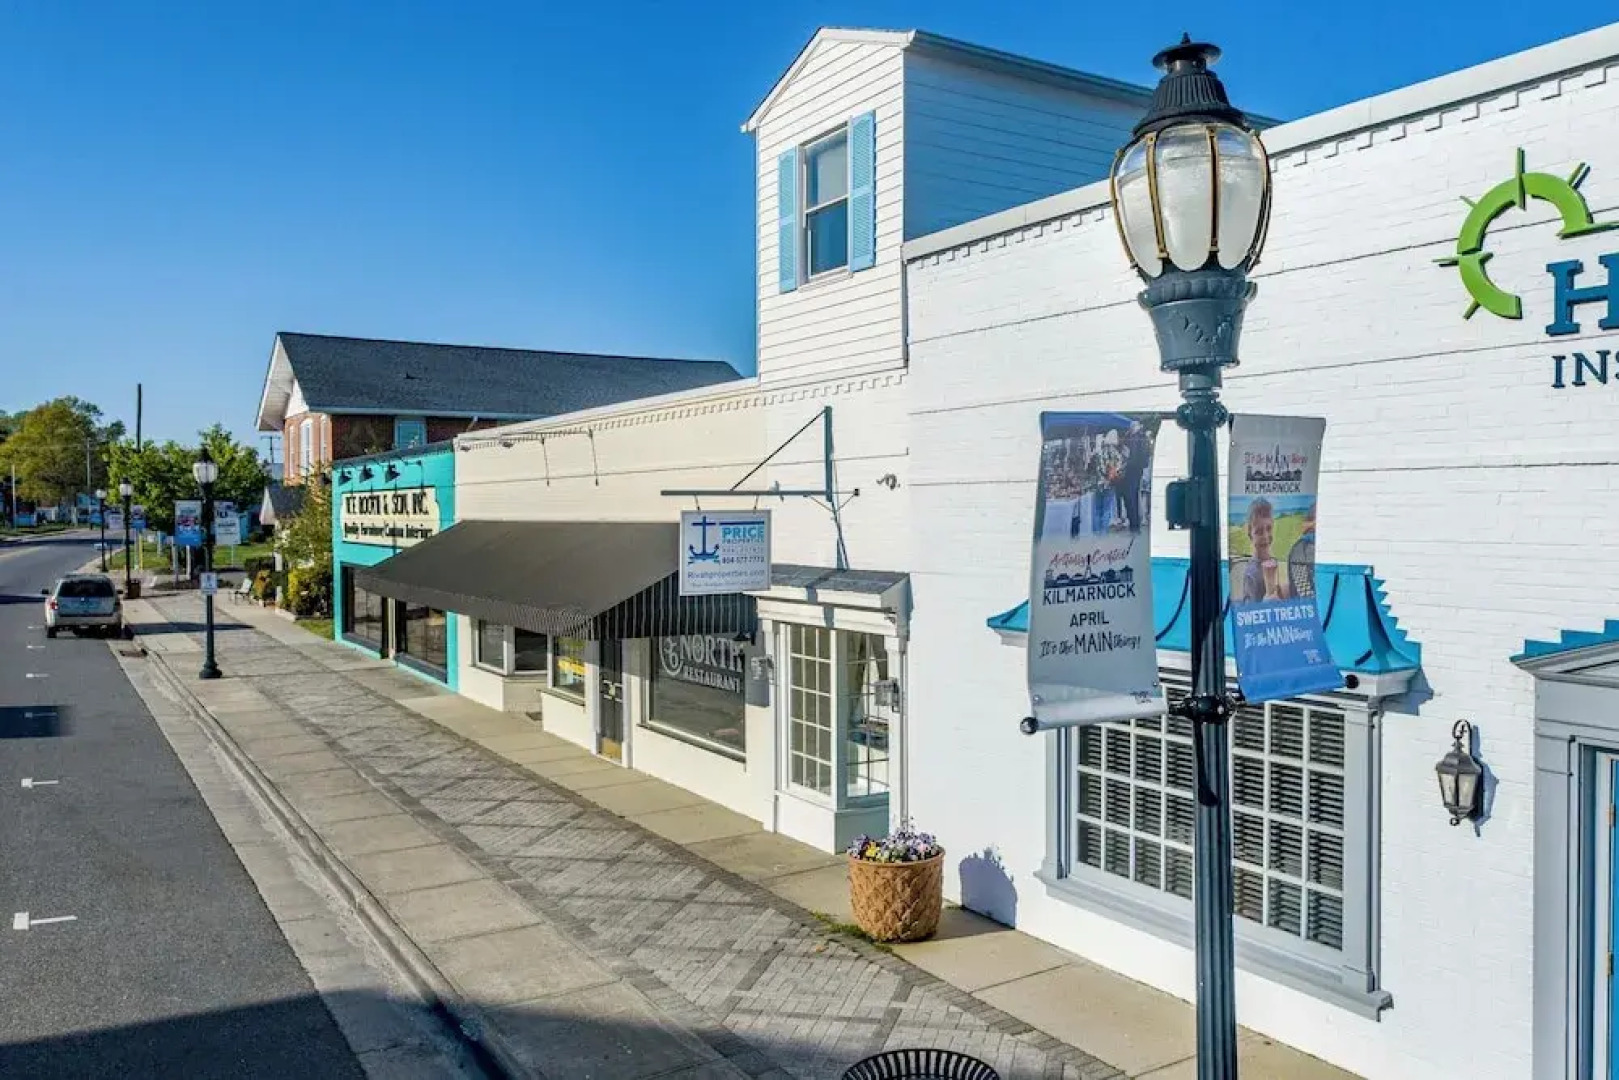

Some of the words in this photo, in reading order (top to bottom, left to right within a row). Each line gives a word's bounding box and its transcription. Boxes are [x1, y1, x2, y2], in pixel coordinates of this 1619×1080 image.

[1551, 350, 1619, 389] IN
[1244, 482, 1301, 494] KILMARNOCK
[722, 526, 764, 539] PRICE
[1043, 583, 1136, 606] KILMARNOCK
[1069, 610, 1110, 628] APRIL
[1236, 608, 1272, 627] SWEET
[1273, 605, 1315, 623] TREATS
[1074, 631, 1113, 654] MAIN
[1266, 626, 1295, 646] MAIN
[680, 634, 743, 673] NORTH
[683, 665, 741, 693] RESTAURANT
